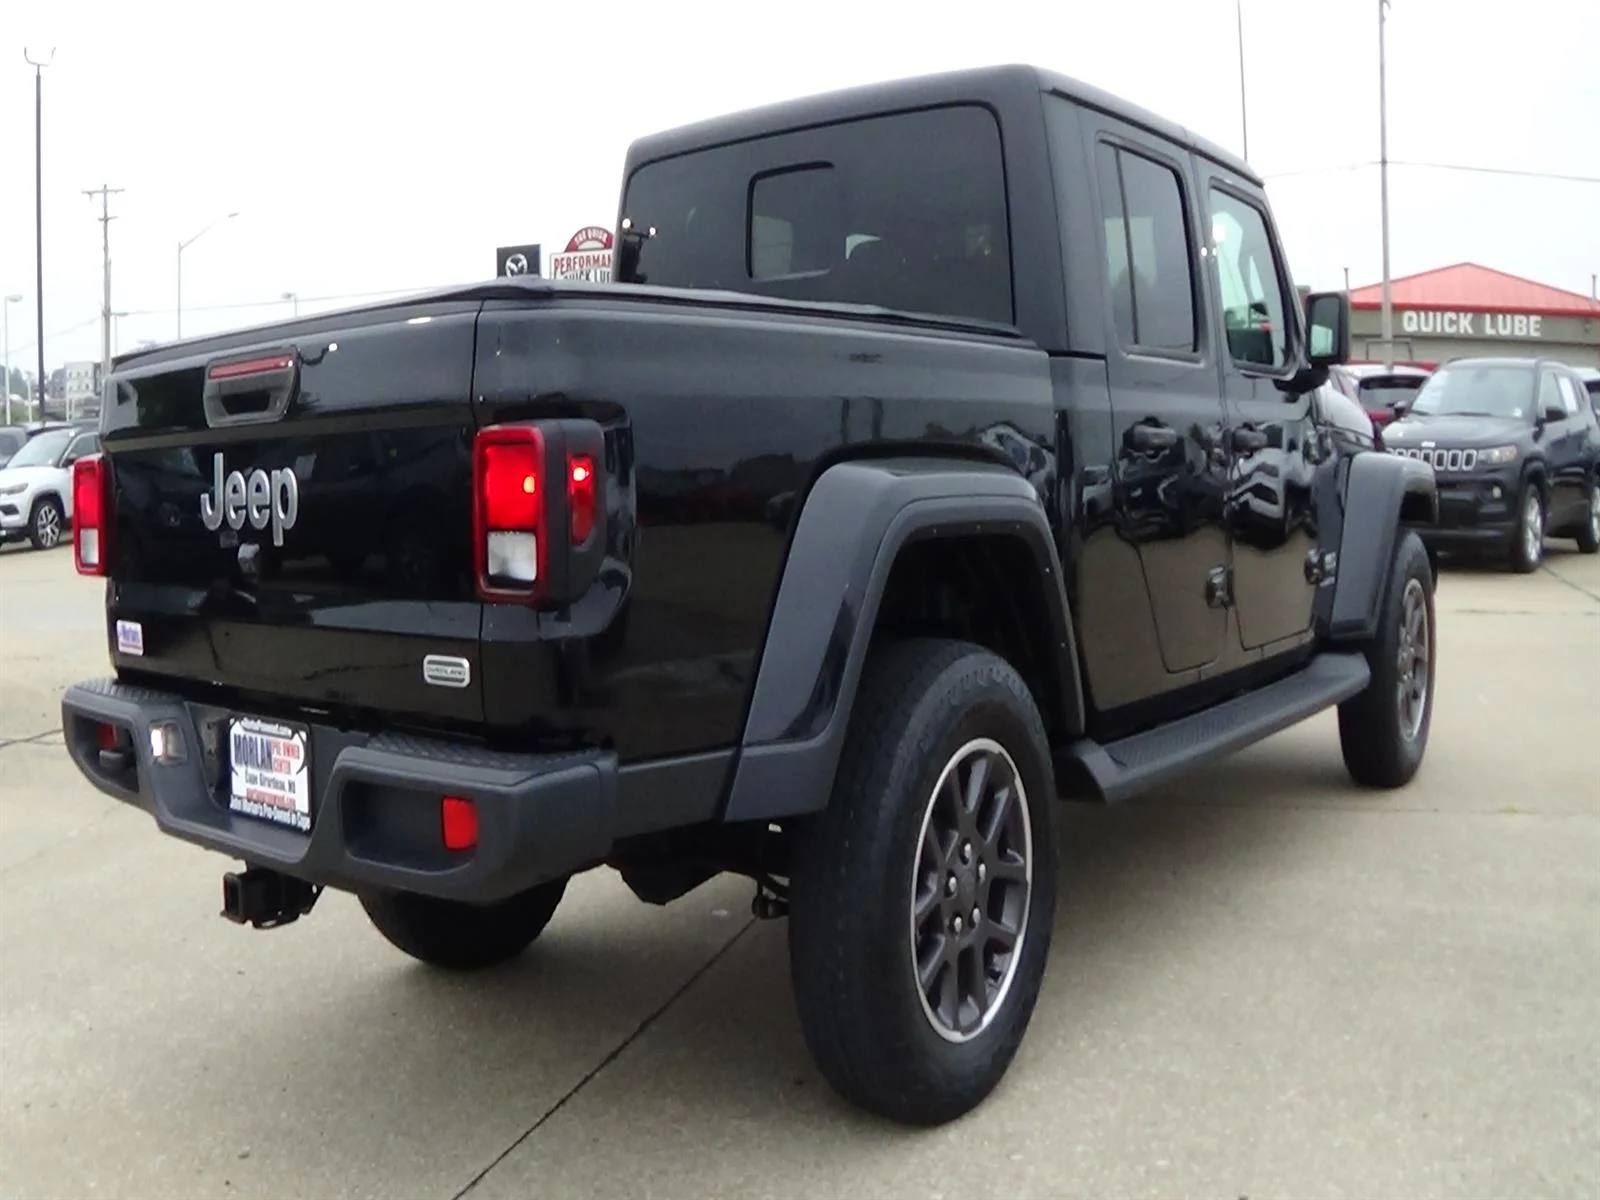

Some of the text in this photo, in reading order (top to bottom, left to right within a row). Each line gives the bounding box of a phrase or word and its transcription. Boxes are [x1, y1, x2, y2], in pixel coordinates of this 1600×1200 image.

[1402, 310, 1542, 337] QUICK LUBE
[200, 452, 298, 547] Jeep
[234, 734, 272, 770] MORLAN
